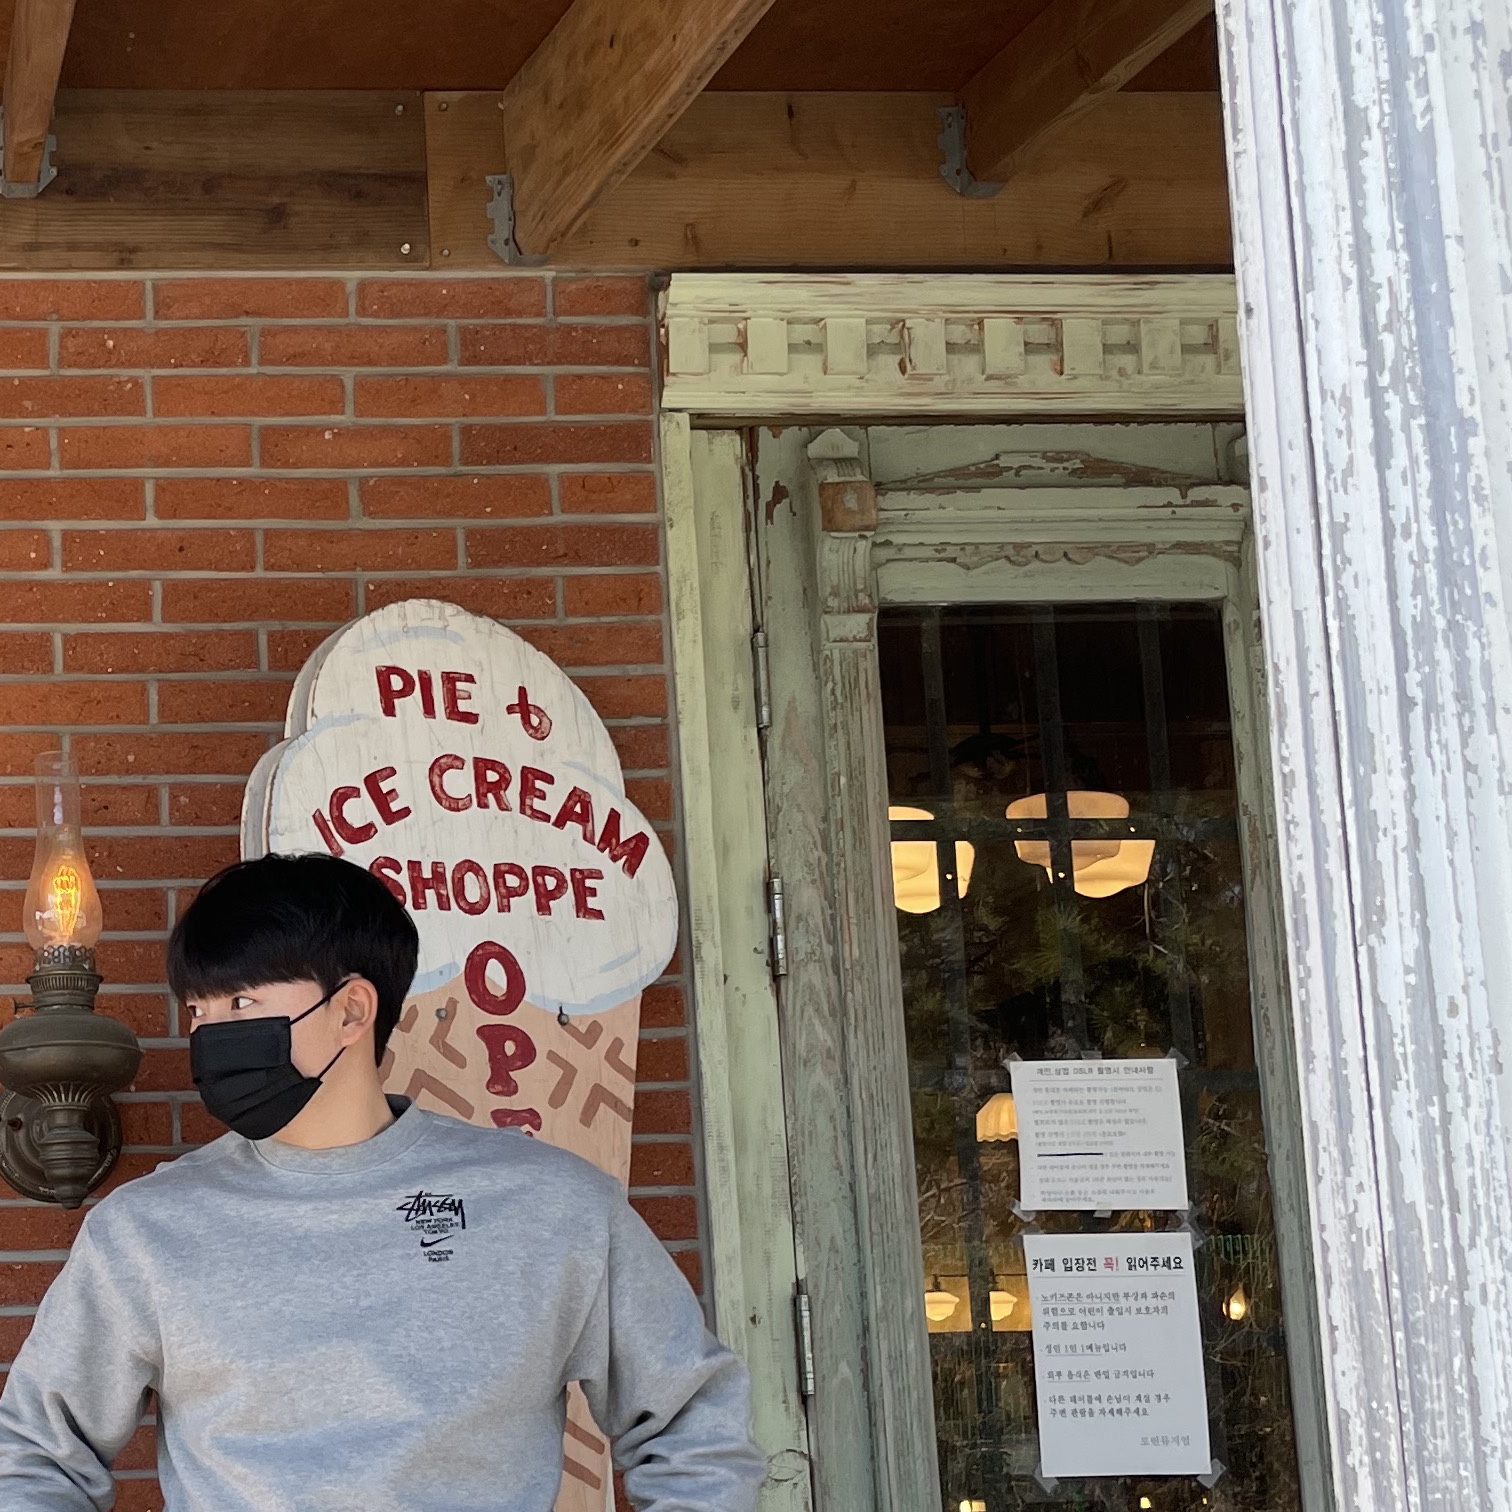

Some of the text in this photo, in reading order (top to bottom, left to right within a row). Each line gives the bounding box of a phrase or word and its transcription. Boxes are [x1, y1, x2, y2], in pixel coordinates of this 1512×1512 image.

[376, 666, 479, 723] PIE
[312, 754, 650, 879] ICE CREAM
[368, 857, 605, 921] SHOPPE
[1033, 1256, 1184, 1272] 카페 입장전 꼭! 읽어주세요
